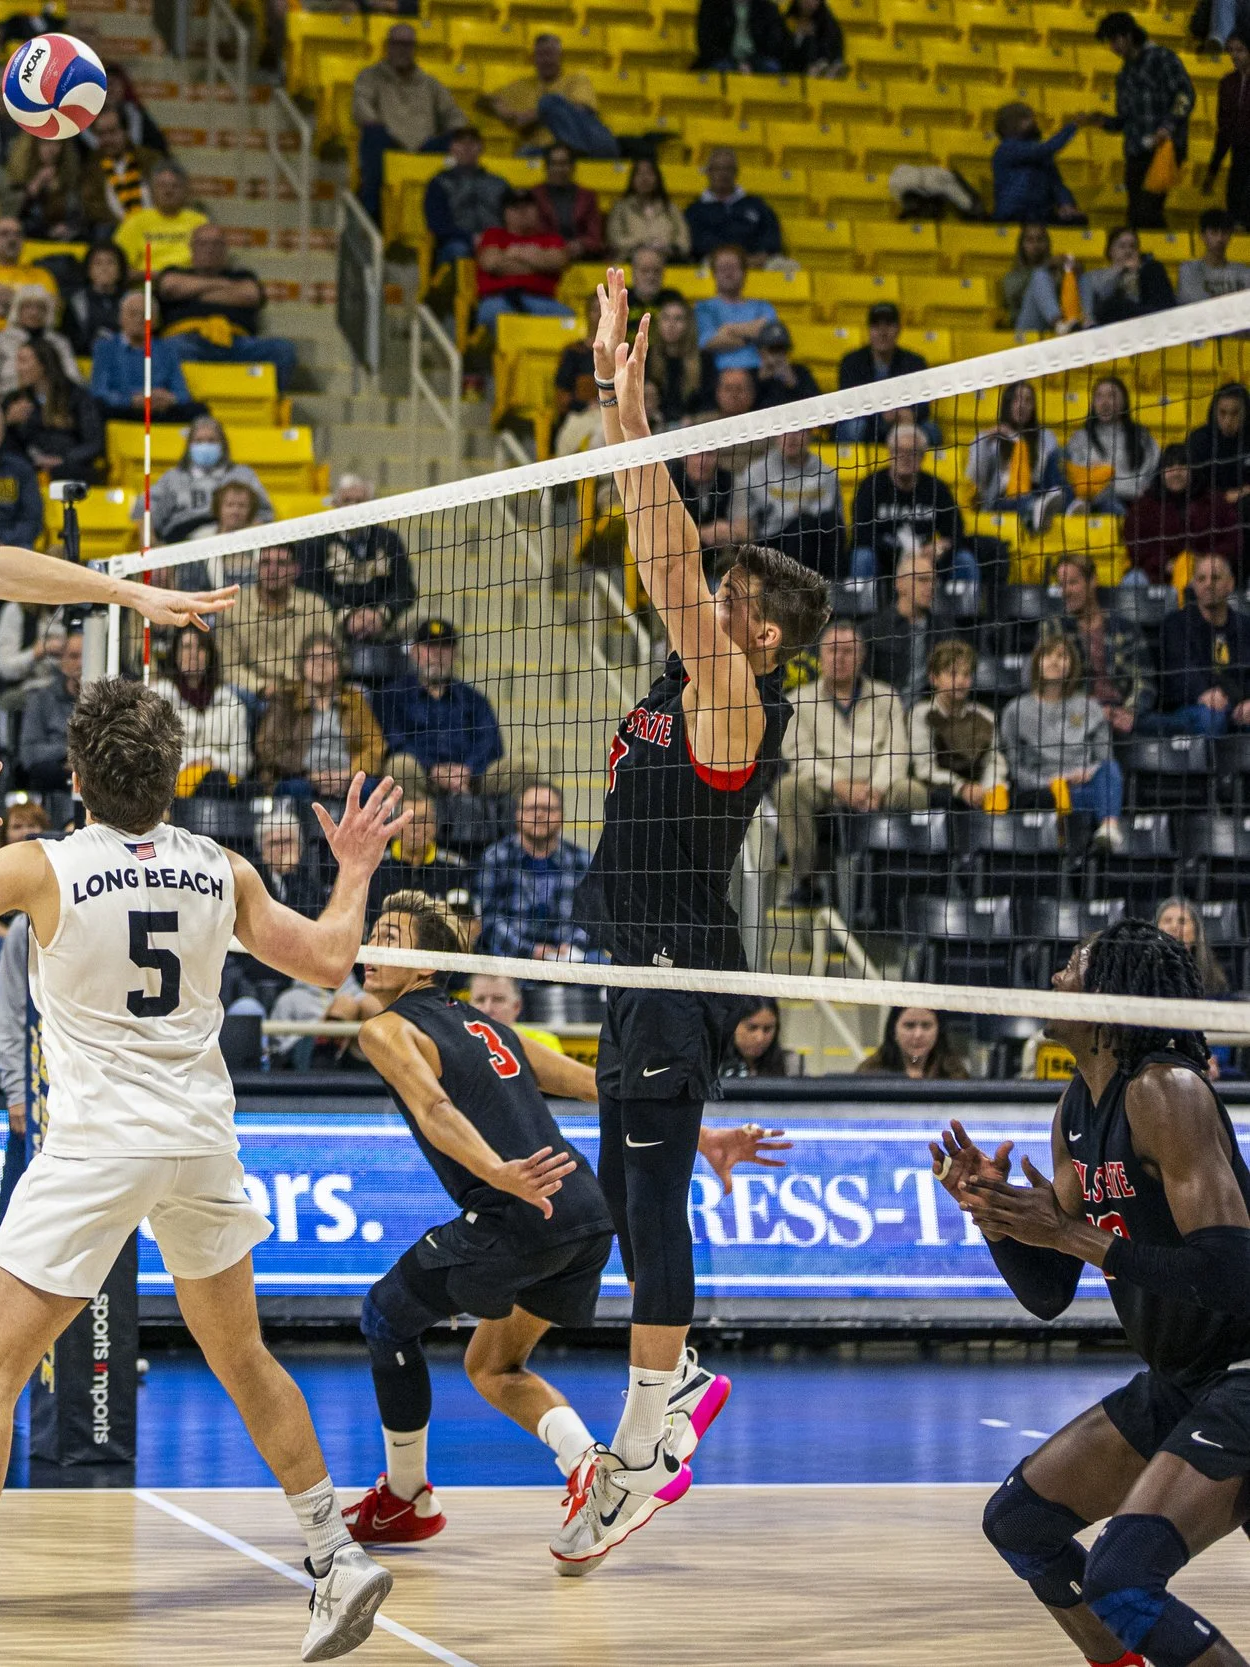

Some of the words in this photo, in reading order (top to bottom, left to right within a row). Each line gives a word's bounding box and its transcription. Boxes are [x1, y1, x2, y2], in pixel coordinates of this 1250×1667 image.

[21, 47, 46, 83] NCAA
[72, 868, 139, 905] LONG
[144, 867, 224, 901] BEACH
[126, 910, 181, 1018] 5
[463, 1020, 521, 1079] 3
[90, 1293, 111, 1360] sports
